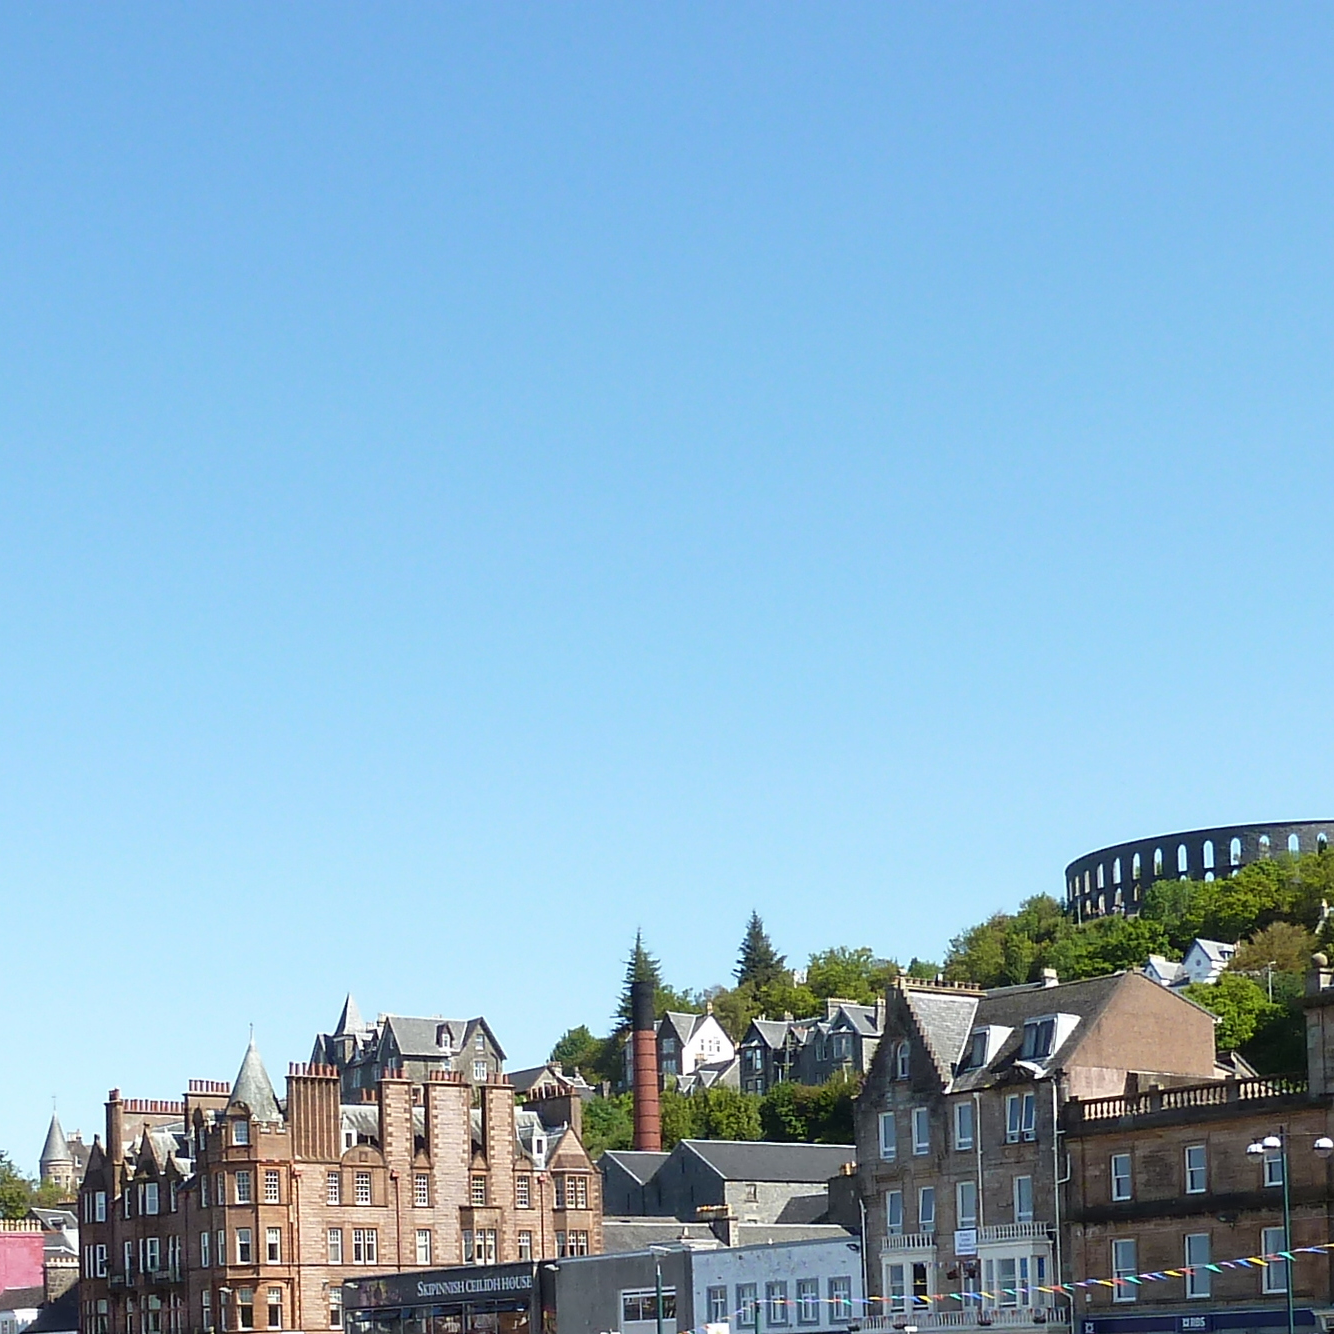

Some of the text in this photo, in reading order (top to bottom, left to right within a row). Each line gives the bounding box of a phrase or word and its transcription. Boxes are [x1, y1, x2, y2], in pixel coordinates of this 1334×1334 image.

[417, 1275, 533, 1297] SKIPINNISH CEILIDH HOUSE
[1190, 1316, 1206, 1328] RBS
